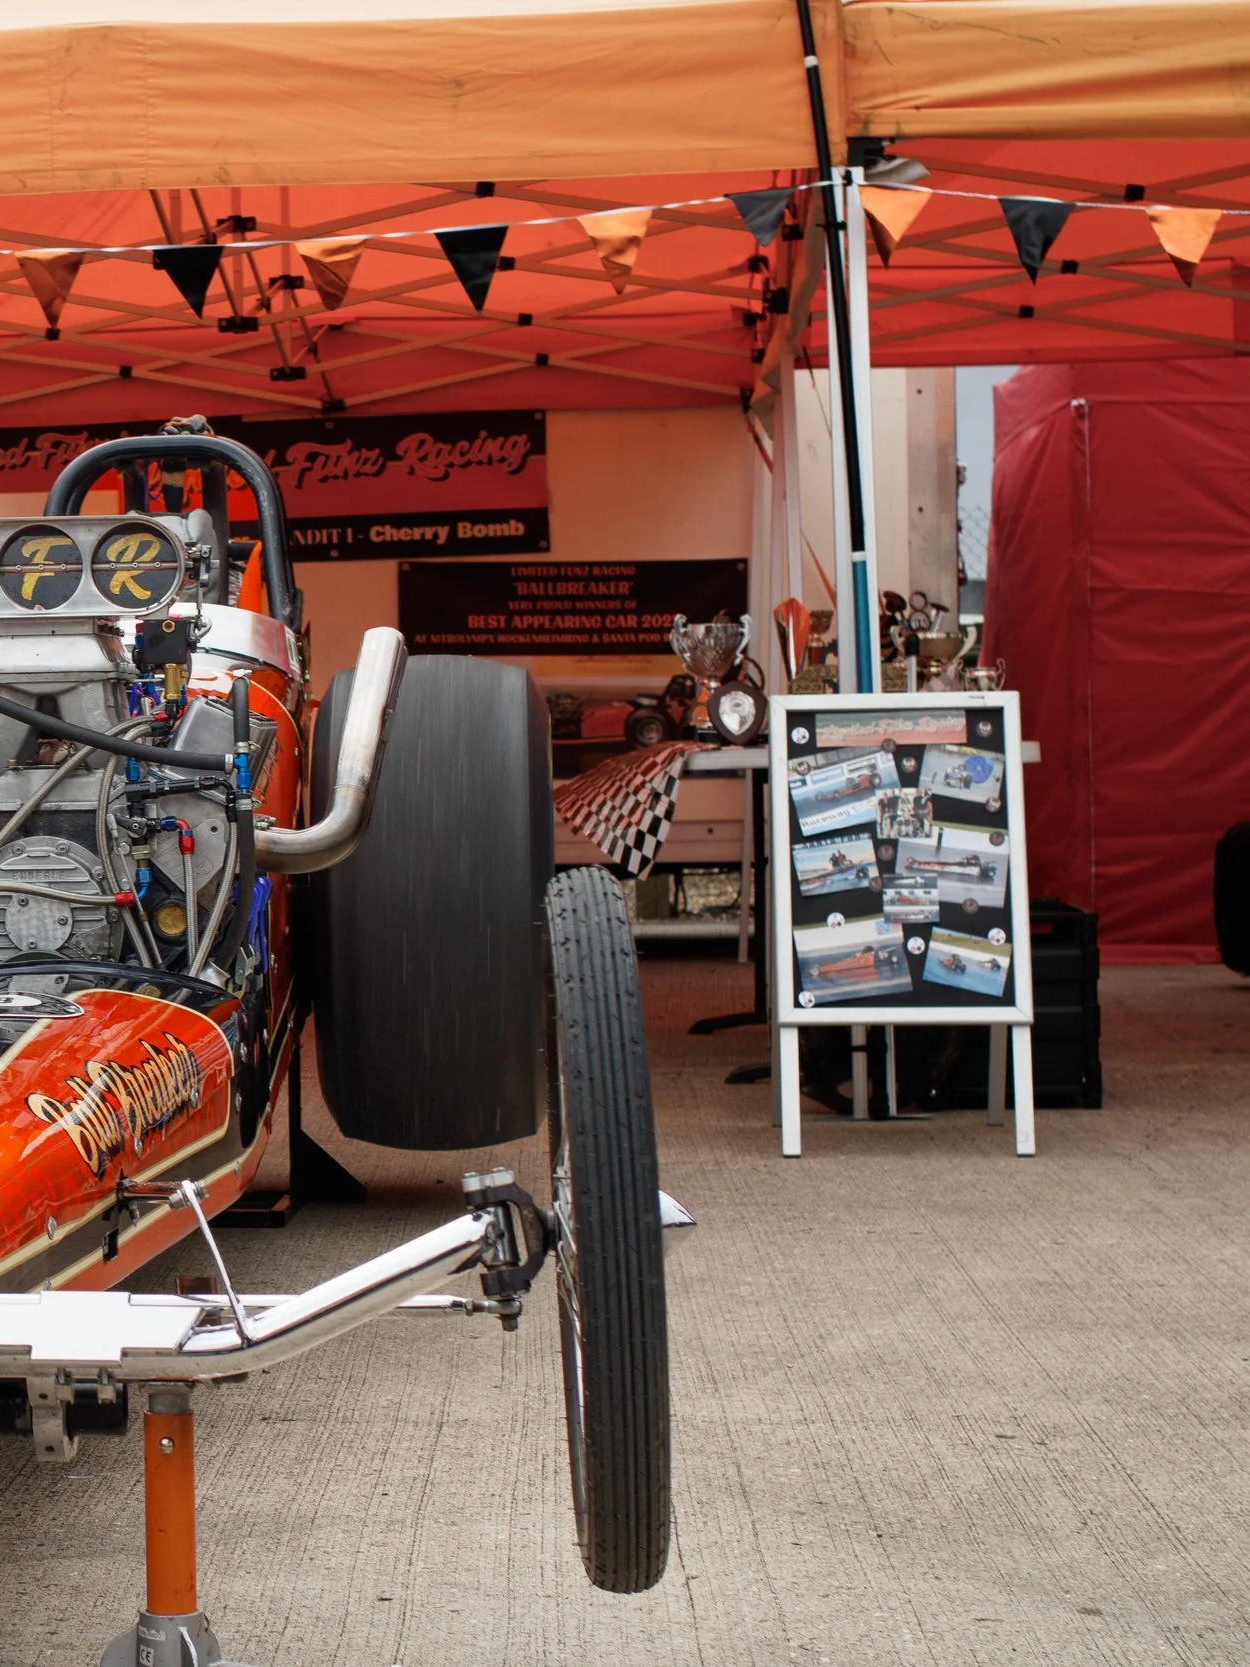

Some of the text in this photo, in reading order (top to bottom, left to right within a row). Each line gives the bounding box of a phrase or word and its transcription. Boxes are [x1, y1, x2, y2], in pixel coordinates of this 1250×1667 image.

[286, 439, 386, 489] Funz
[396, 432, 532, 482] Racing
[369, 523, 450, 545] Cherry
[457, 519, 525, 539] Bomb
[592, 565, 636, 576] RACING
[467, 614, 676, 629] BEST APPEARING CAR 202
